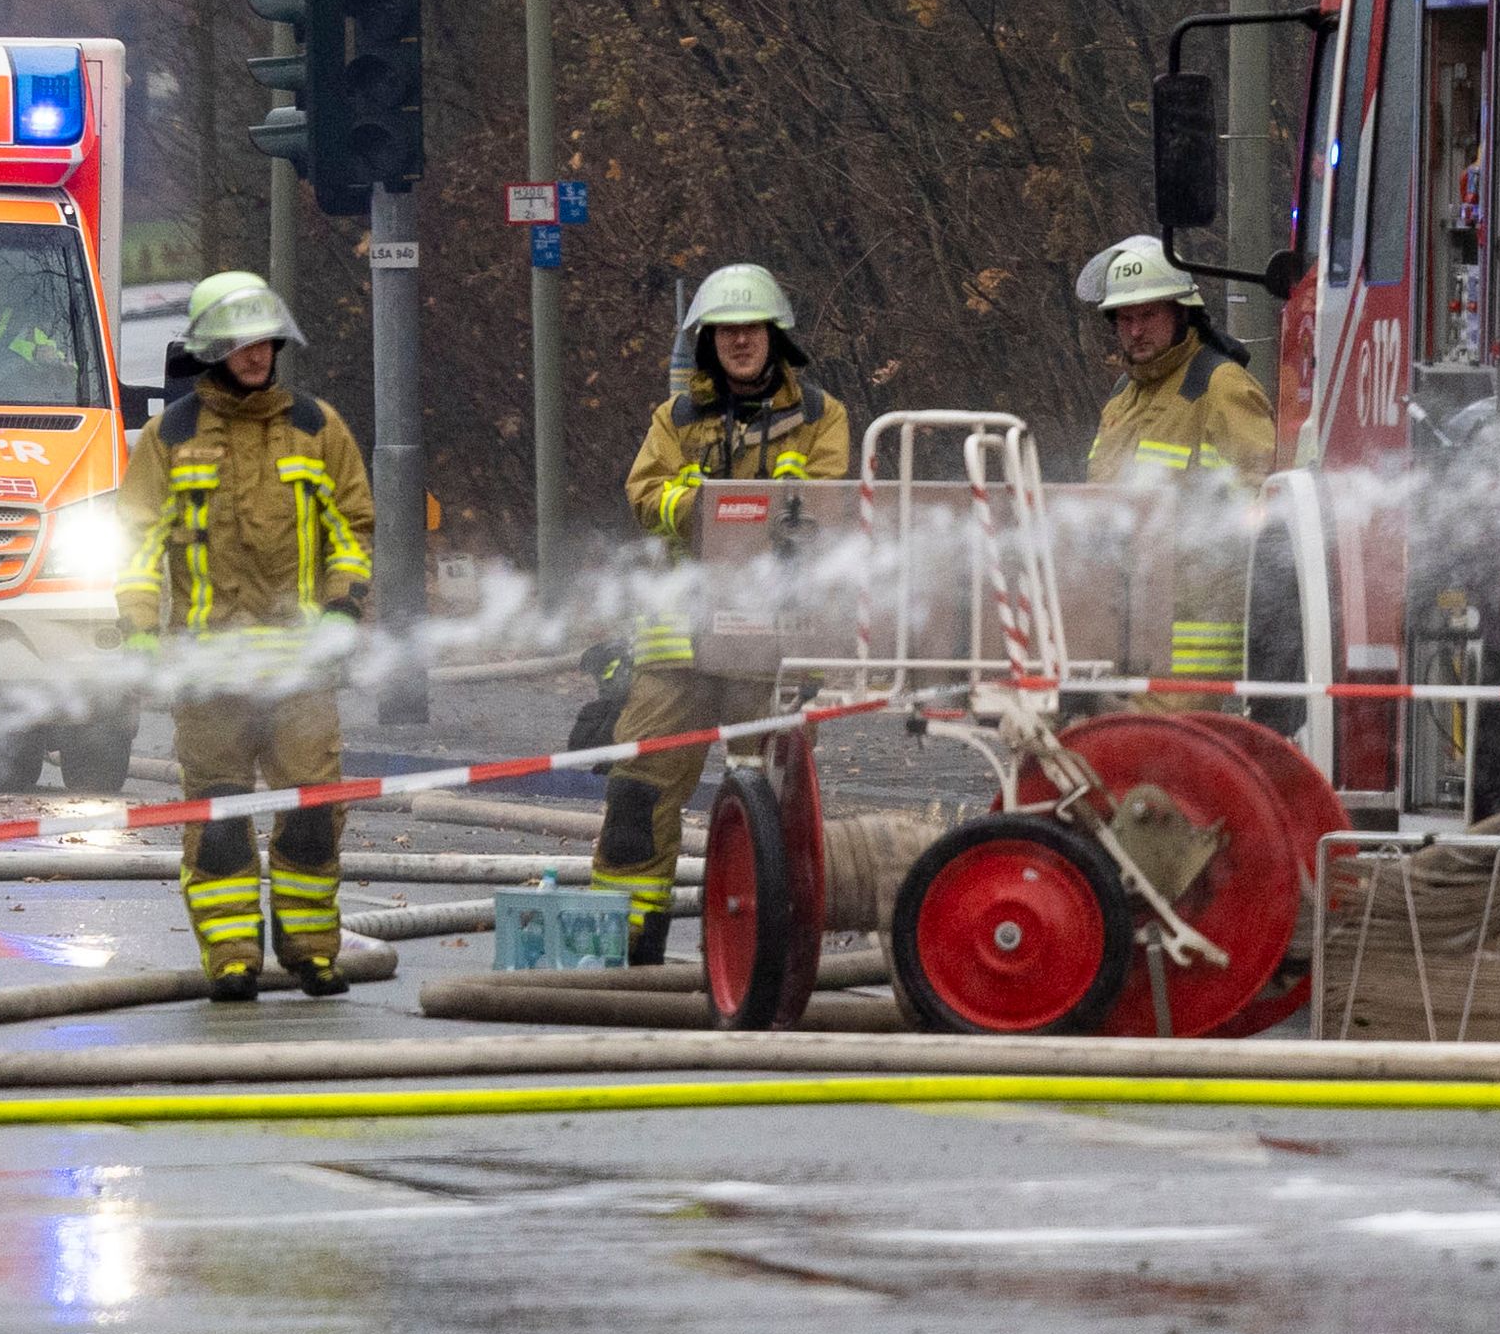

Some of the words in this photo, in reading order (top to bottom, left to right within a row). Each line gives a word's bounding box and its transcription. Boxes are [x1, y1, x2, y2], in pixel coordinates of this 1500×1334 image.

[371, 248, 393, 260] LSA
[1114, 261, 1143, 281] 750
[1373, 317, 1400, 427] 112
